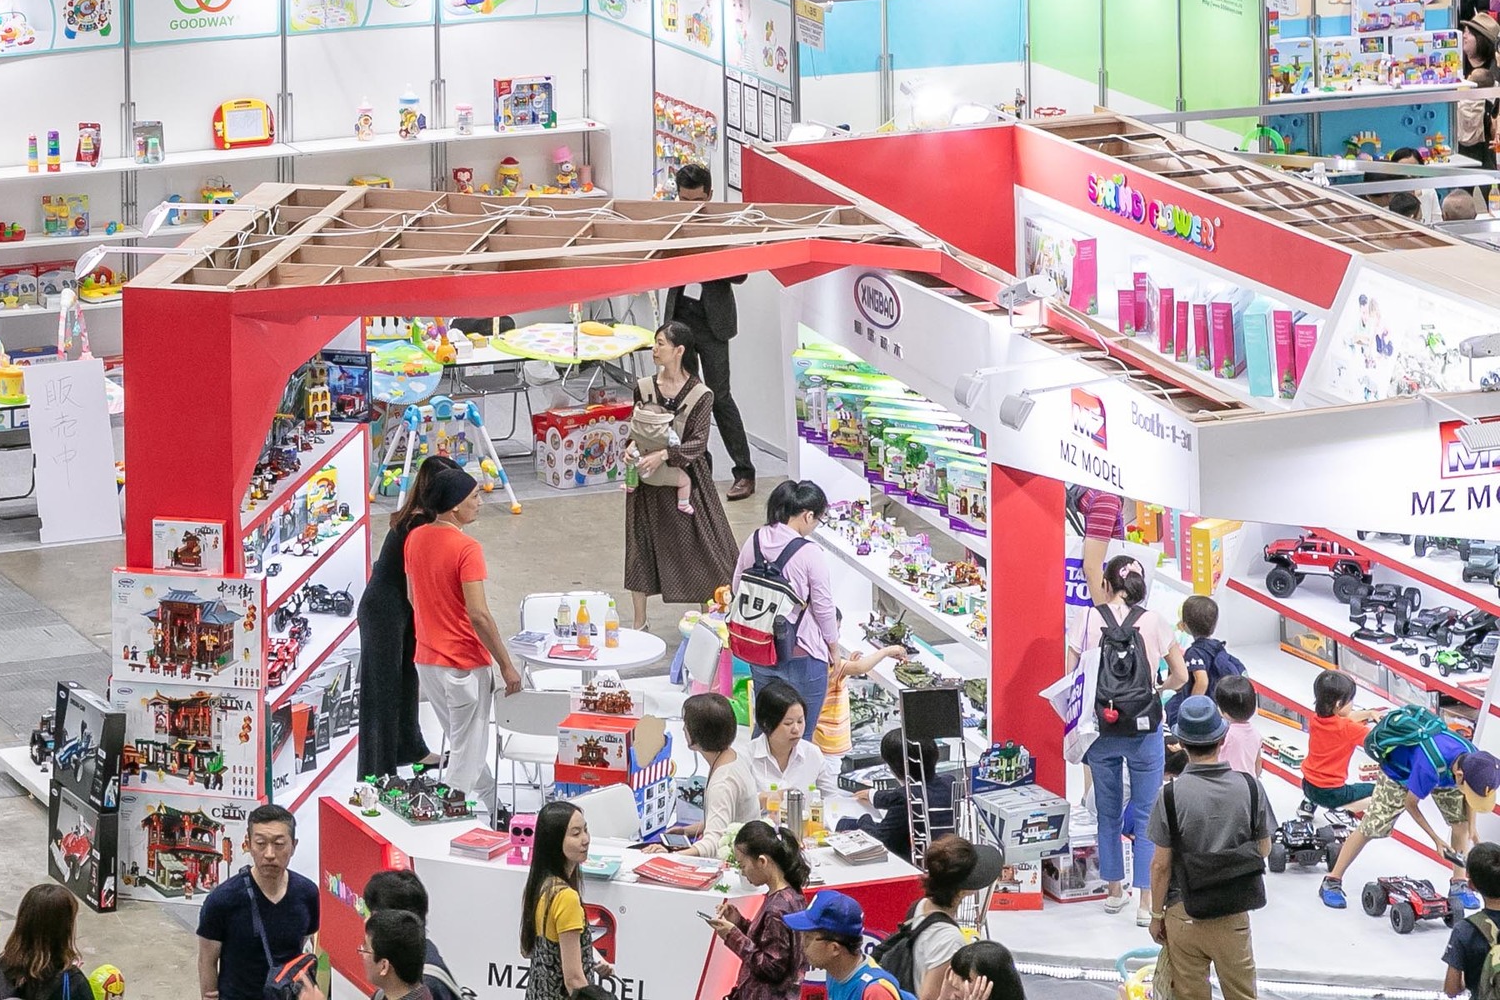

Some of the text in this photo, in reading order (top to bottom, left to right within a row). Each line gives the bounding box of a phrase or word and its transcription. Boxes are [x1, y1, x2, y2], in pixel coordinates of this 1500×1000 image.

[170, 15, 234, 30] GOODWAY
[1087, 172, 1214, 252] SPRING FLOWER
[860, 283, 895, 320] XINGBAO
[1059, 440, 1125, 490] MZ MODEL
[1411, 488, 1456, 517] MZ
[599, 734, 623, 744] CHINA
[211, 803, 248, 819] CHIN
